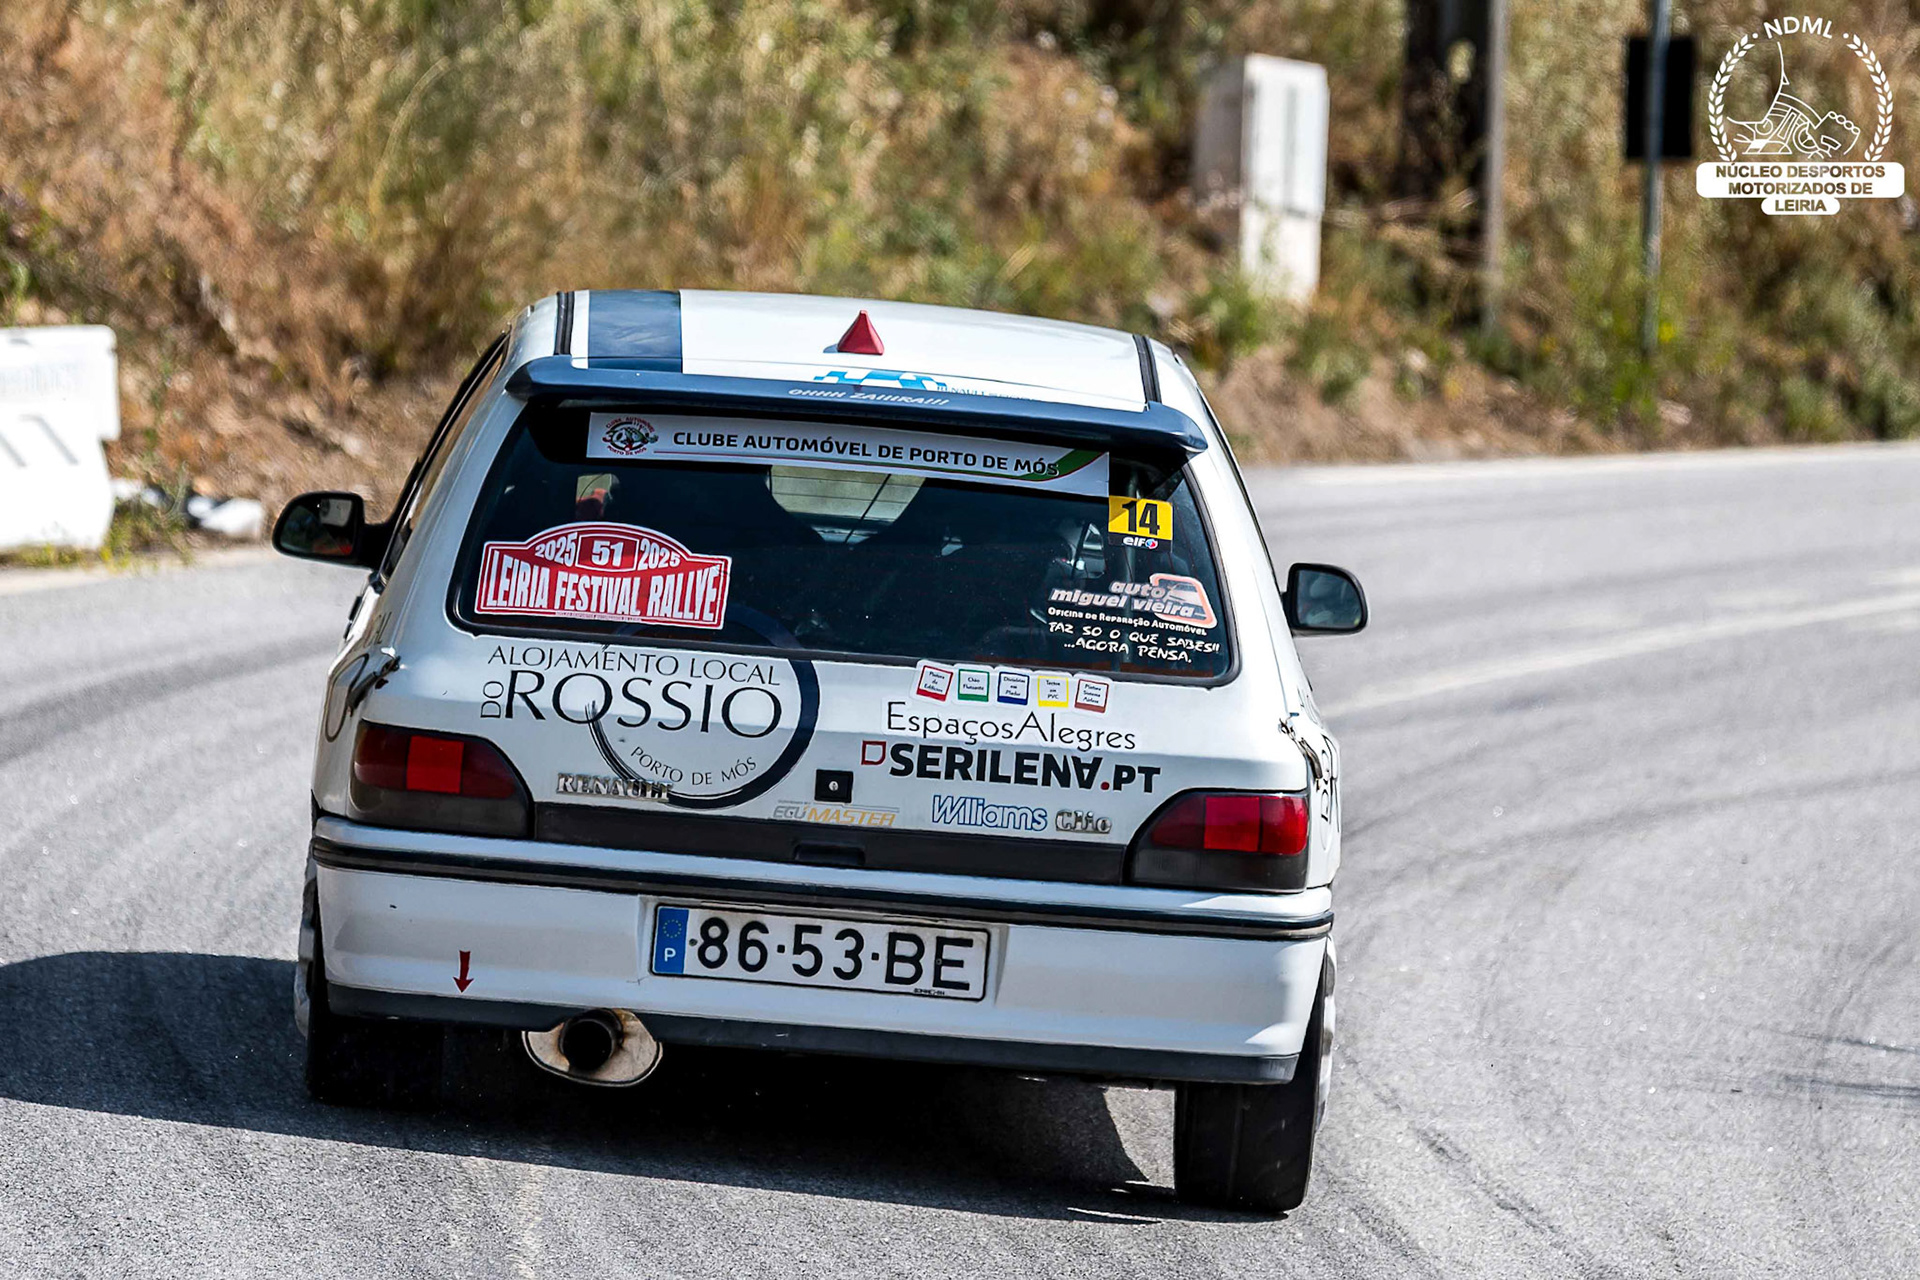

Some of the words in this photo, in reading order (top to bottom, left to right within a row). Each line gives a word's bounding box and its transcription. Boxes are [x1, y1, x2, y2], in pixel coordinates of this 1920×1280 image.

[673, 432, 738, 448] CLUBE
[743, 435, 872, 457] AUTOMÓVEL
[878, 444, 904, 459] DE
[909, 447, 977, 467] PORTO
[983, 455, 1008, 470] DE
[1014, 458, 1060, 476] MÓS
[1122, 500, 1160, 536] 14
[535, 532, 578, 567] 2025
[591, 540, 623, 567] 51
[638, 538, 681, 571] 2025
[486, 549, 550, 609] LEIRIA
[554, 570, 641, 616] FESTIVAL
[647, 564, 721, 622] RALLYE
[1049, 588, 1127, 608] miguel
[1131, 598, 1196, 618] vieira
[1109, 580, 1165, 599] auto
[1048, 621, 1074, 634] FAZ
[1109, 629, 1121, 639] O
[1129, 631, 1159, 645] QUE
[487, 644, 680, 676] ALOJAMENTO
[689, 657, 781, 686] LOCAL
[1137, 645, 1192, 663] PENSA.
[480, 680, 504, 719] DO
[504, 669, 782, 738] ROSSIO
[630, 745, 683, 784] PORTO
[691, 771, 713, 785] DE
[721, 756, 758, 783] MÓS
[556, 772, 673, 802] RENAULT
[932, 794, 1048, 832] Williams
[1055, 808, 1113, 834] Clio
[663, 947, 676, 962] P
